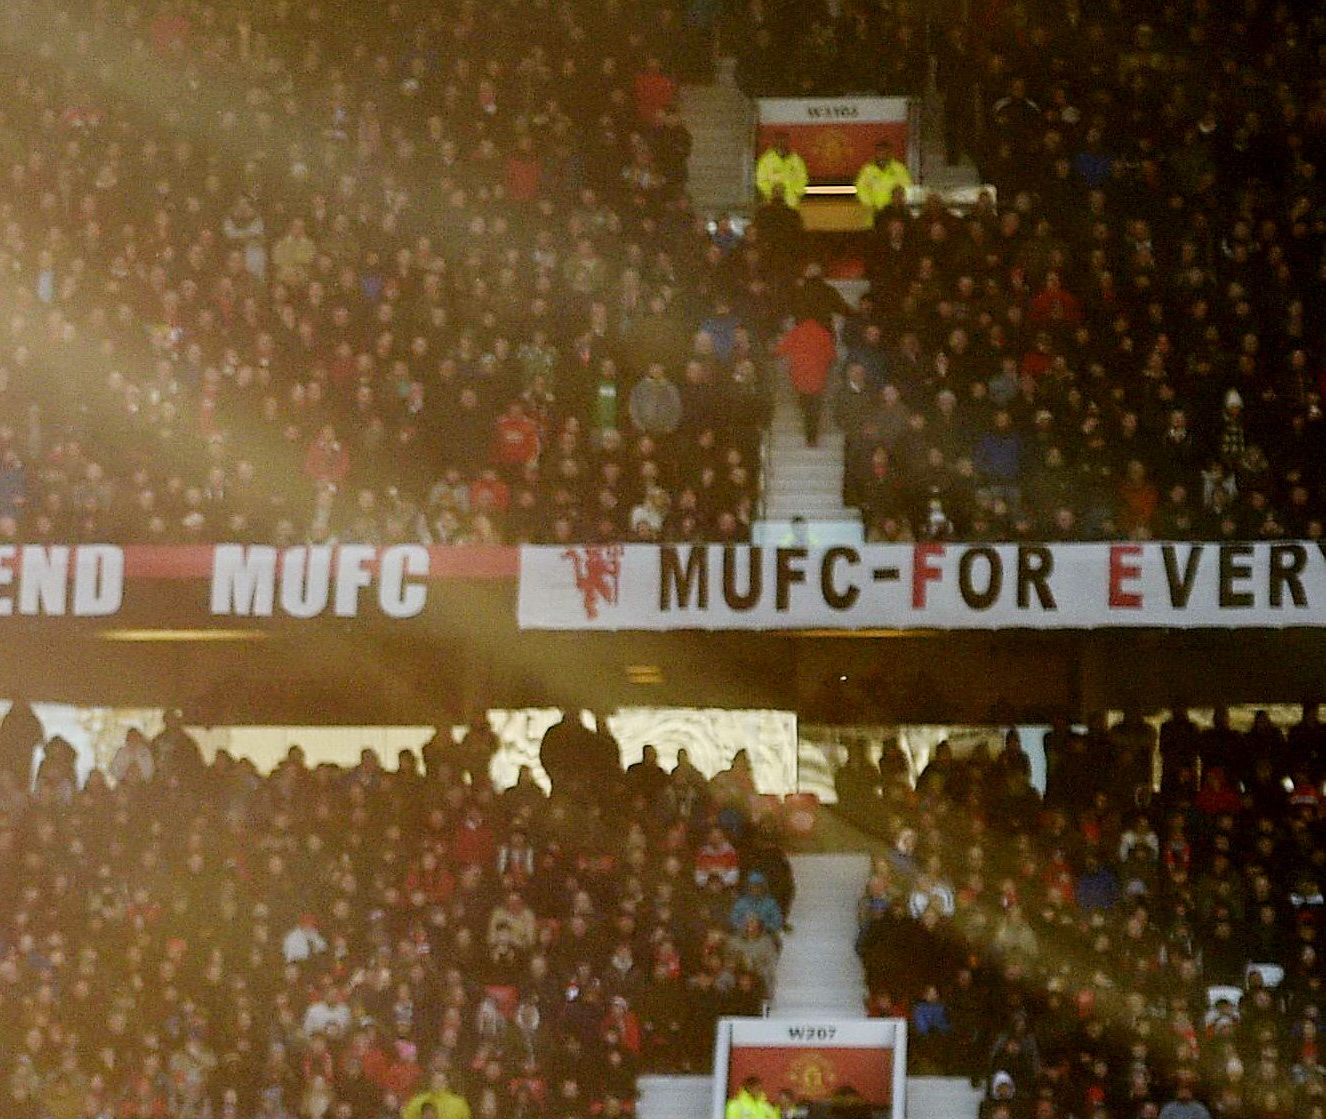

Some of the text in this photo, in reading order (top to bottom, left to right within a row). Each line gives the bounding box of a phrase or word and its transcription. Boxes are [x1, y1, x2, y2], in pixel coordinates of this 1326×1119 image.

[209, 543, 432, 617] MUFC
[1108, 544, 1326, 611] EVER
[788, 1026, 837, 1040] W207
